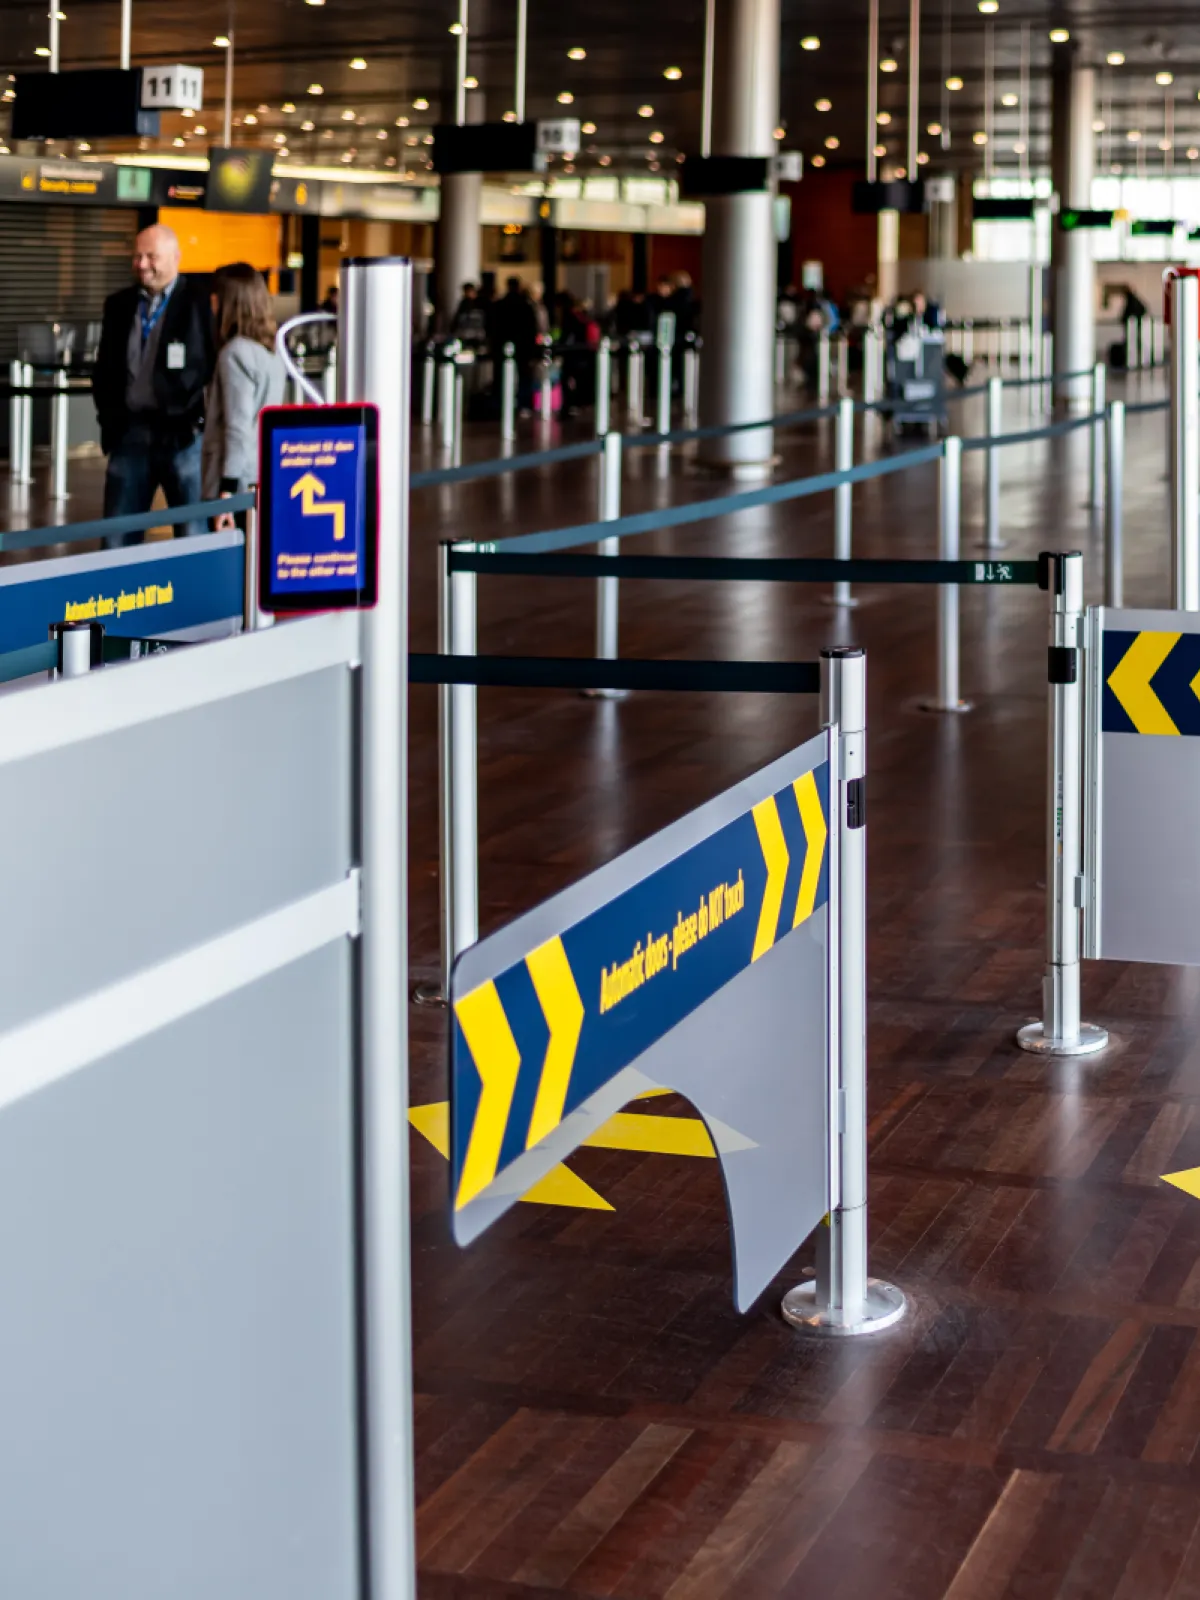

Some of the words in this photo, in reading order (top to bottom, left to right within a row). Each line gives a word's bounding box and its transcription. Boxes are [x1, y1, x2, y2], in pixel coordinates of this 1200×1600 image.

[147, 76, 173, 98] 11
[180, 77, 199, 100] 11
[277, 553, 312, 566] Please
[313, 551, 357, 564] continue
[277, 568, 289, 580] to
[290, 566, 307, 578] the
[309, 565, 336, 578] other
[336, 563, 357, 576] end
[600, 940, 645, 1015] Automatic
[645, 932, 668, 980] doors
[672, 911, 698, 971] please
[698, 894, 708, 940] do
[708, 883, 725, 932] NOT
[724, 868, 745, 921] touch
